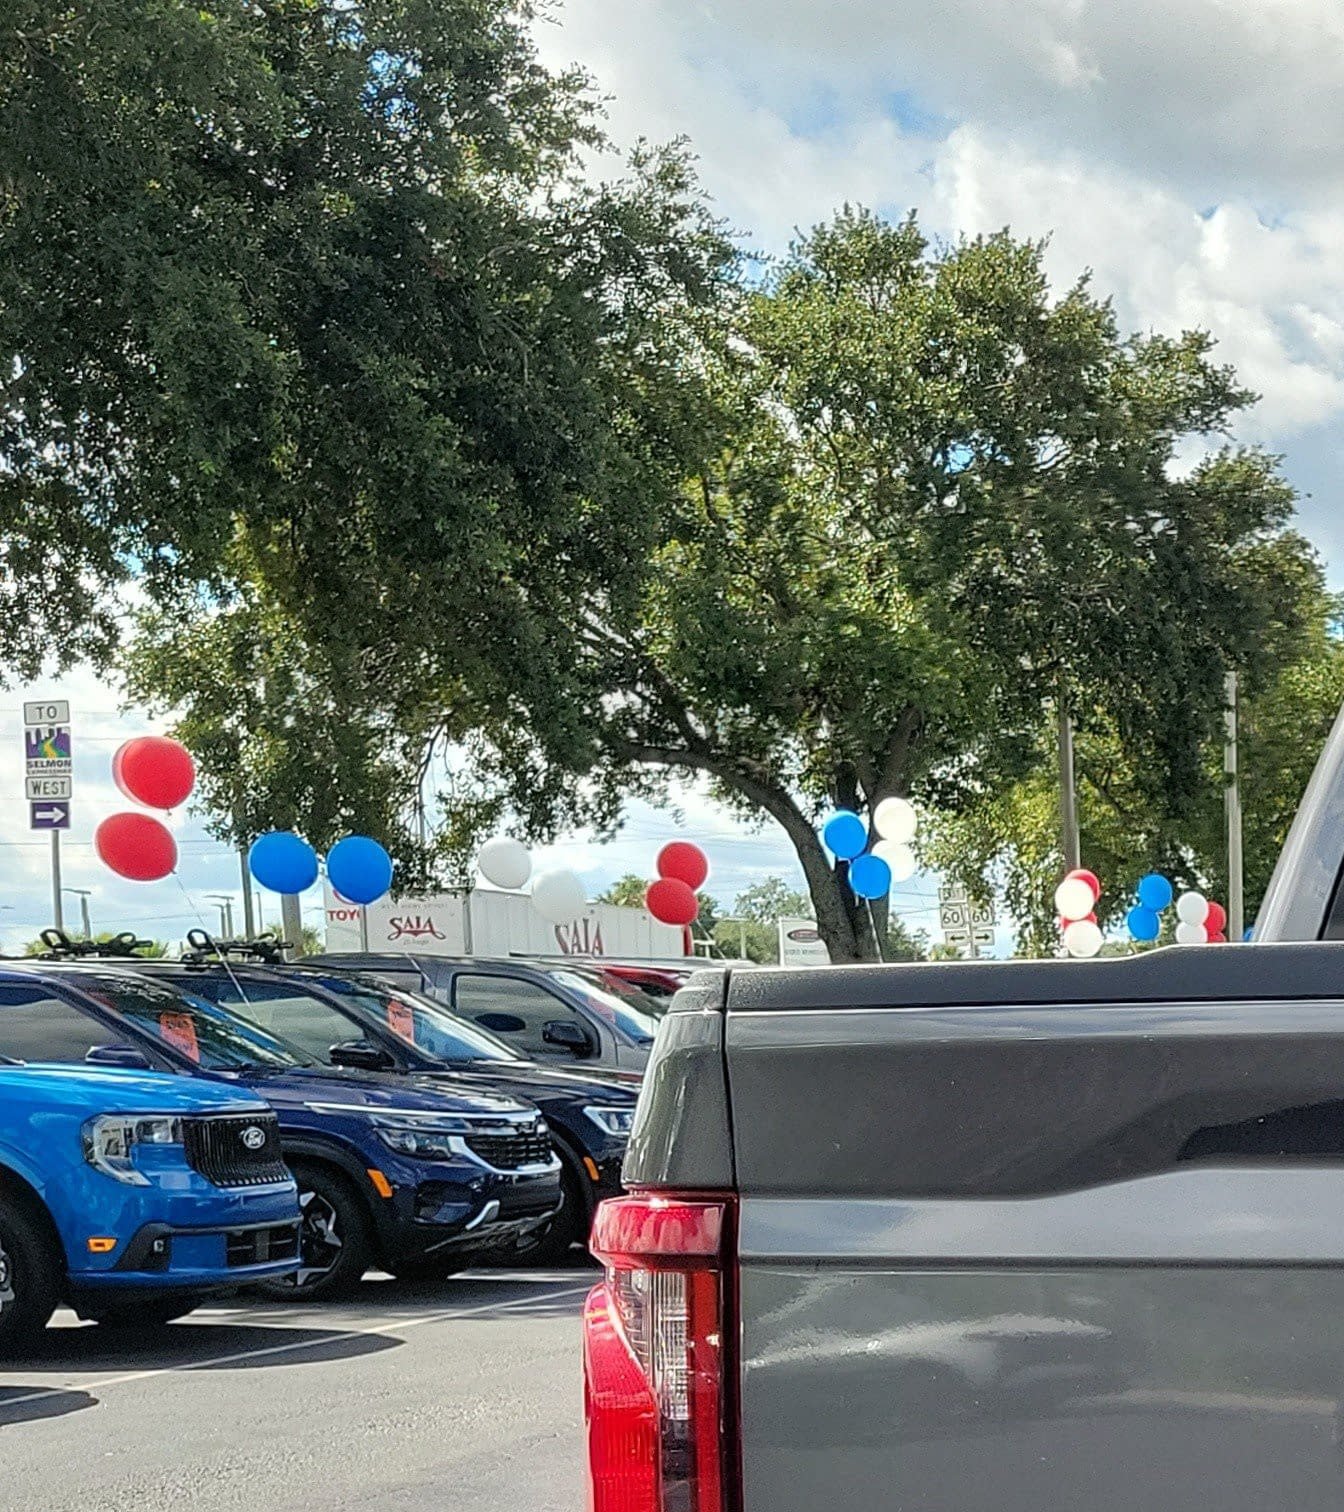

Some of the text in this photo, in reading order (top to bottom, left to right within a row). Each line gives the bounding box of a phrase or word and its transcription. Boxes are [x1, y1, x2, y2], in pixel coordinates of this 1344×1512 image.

[36, 705, 57, 719] TO
[31, 780, 66, 795] WEST
[943, 911, 960, 924] 60
[972, 909, 989, 923] 60
[387, 915, 447, 941] SAIA
